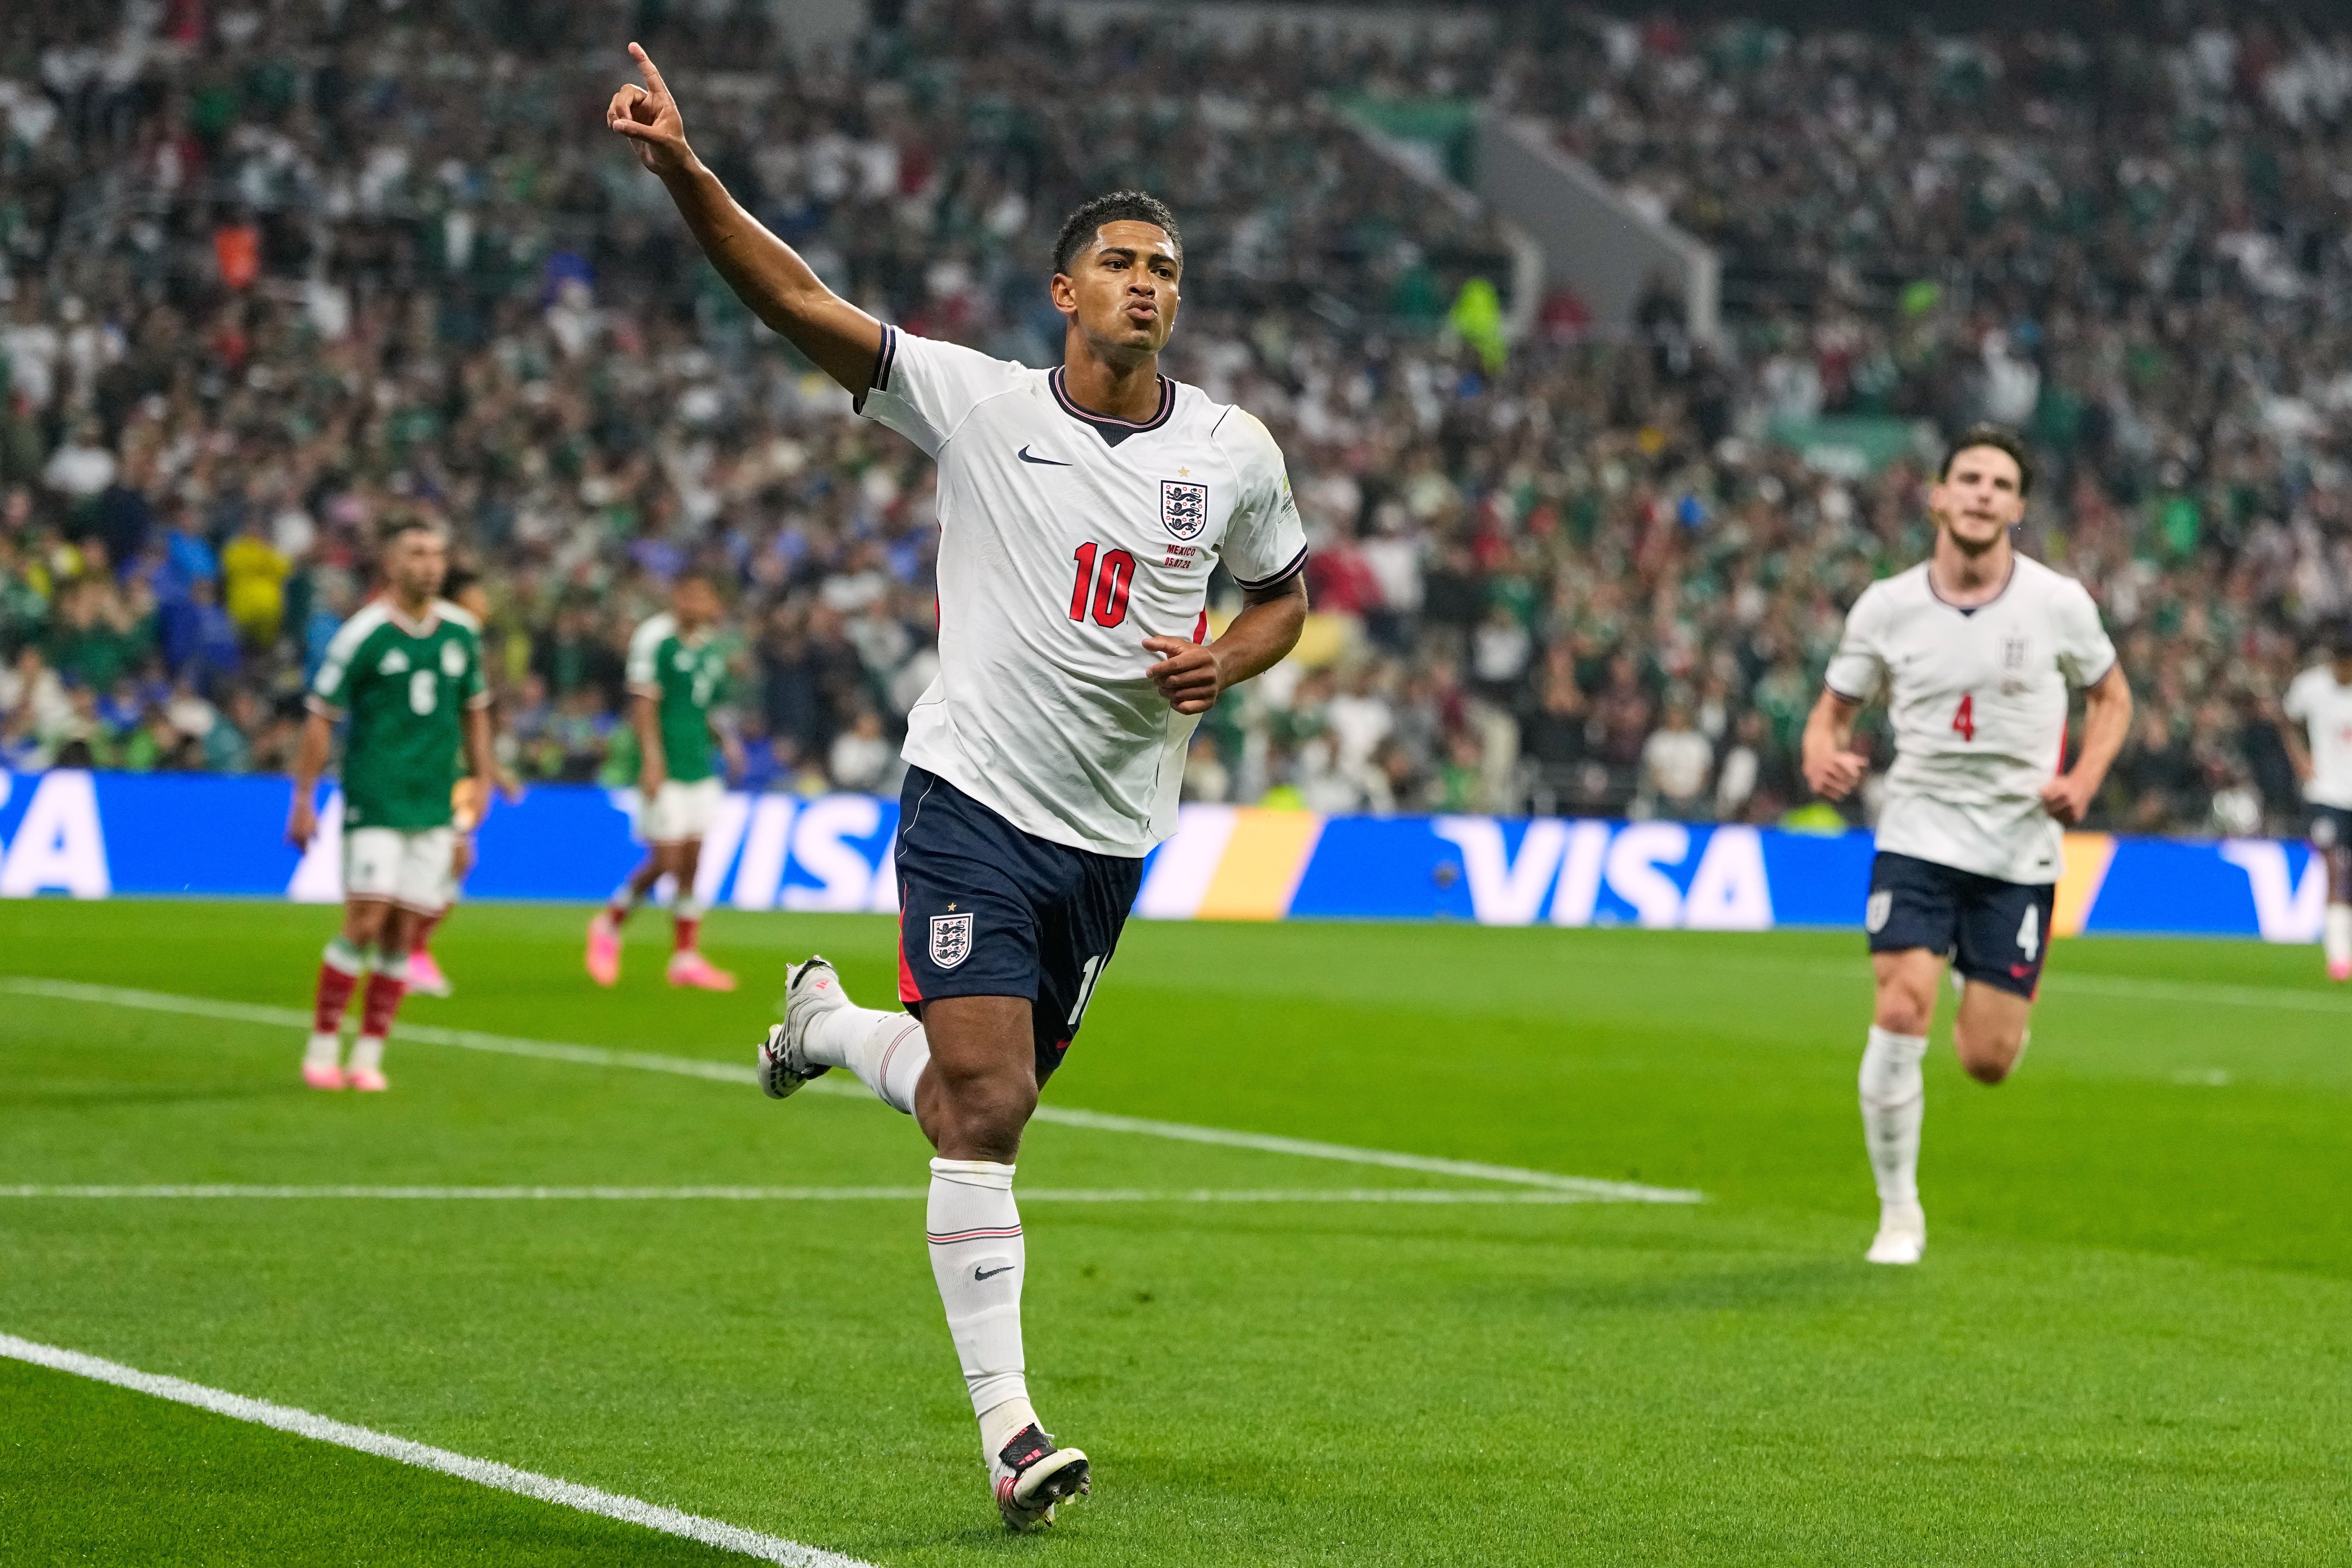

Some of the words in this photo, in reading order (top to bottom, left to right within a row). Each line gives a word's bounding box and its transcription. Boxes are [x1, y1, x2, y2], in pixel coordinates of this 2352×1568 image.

[1165, 557, 1191, 569] 05.07.26
[1167, 544, 1196, 556] MEXICO
[1069, 542, 1136, 629] 10
[1952, 691, 1976, 742] 4
[0, 767, 112, 899] A
[1431, 816, 1775, 929] VISA
[2016, 904, 2040, 962] 4
[1068, 950, 1109, 1026] 1
